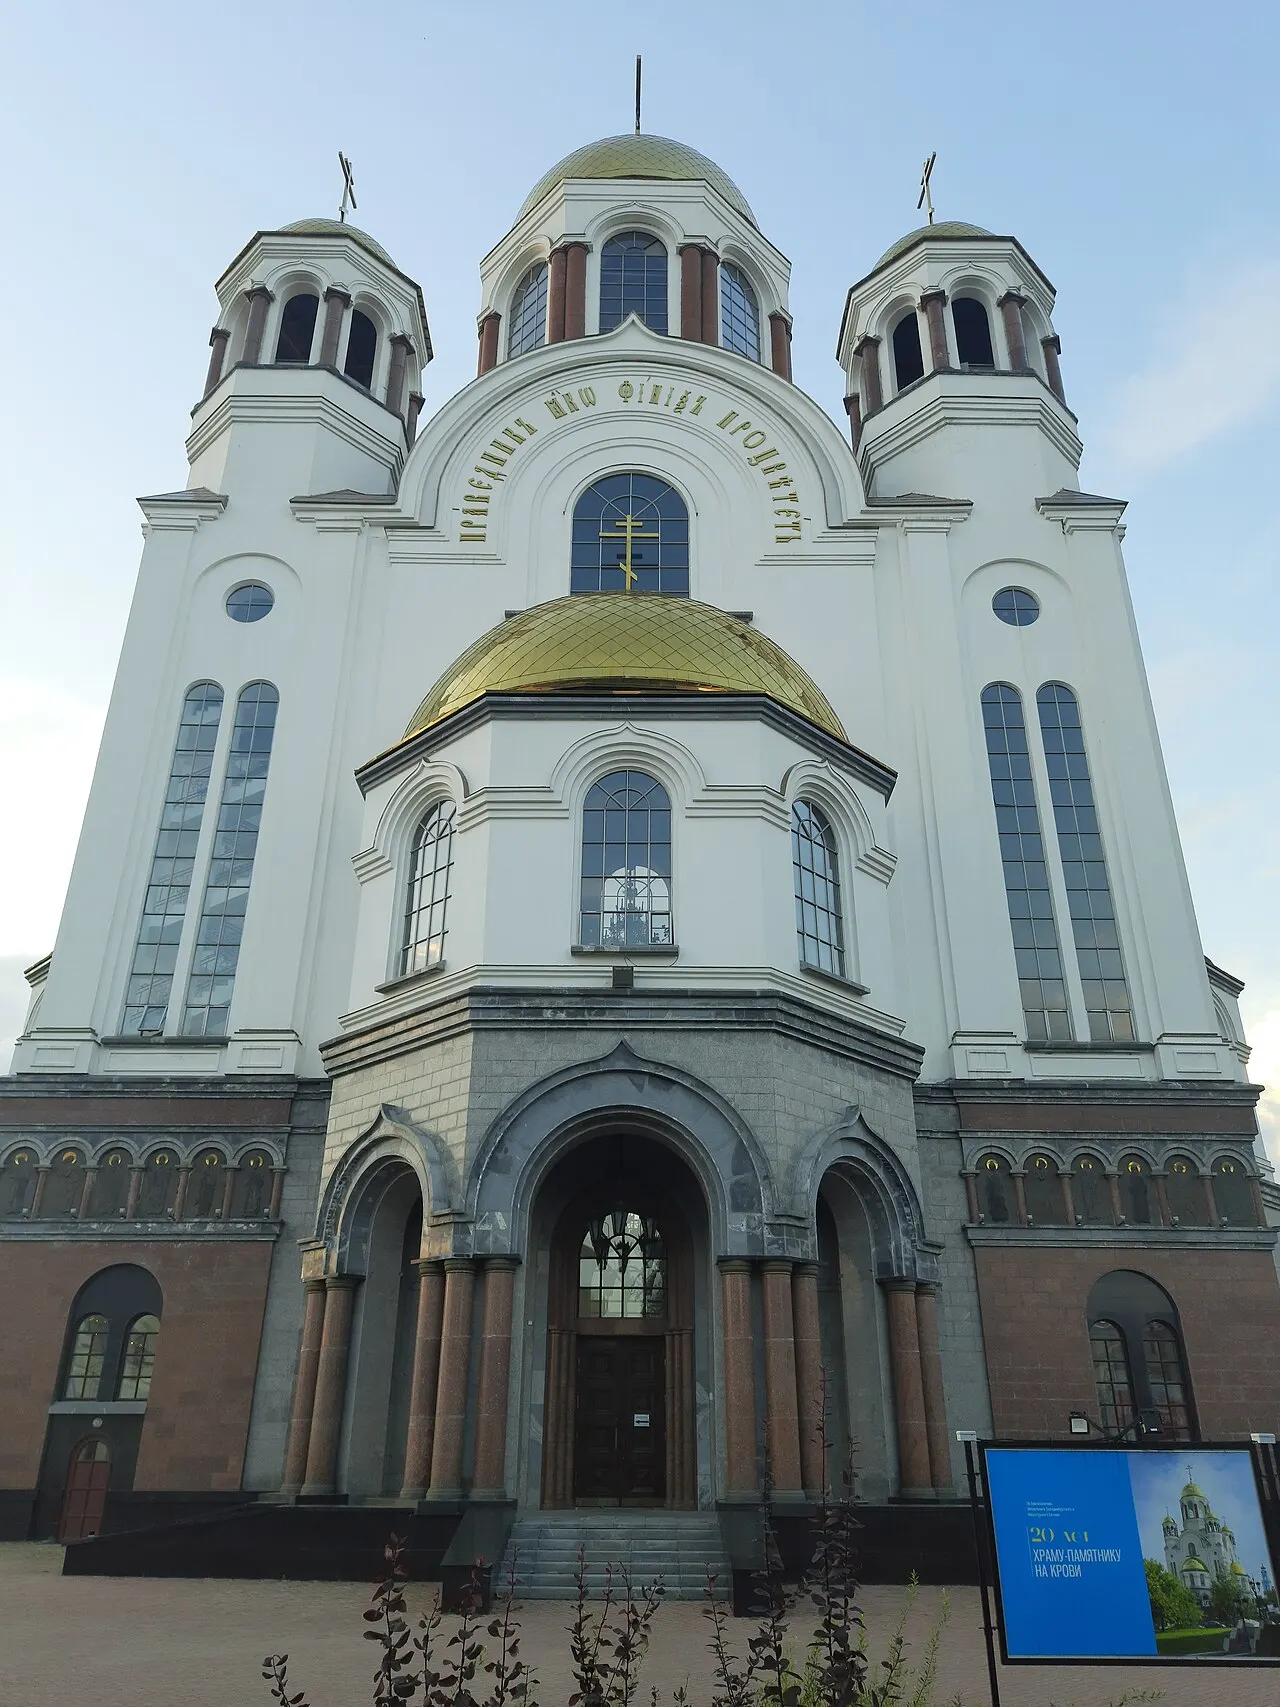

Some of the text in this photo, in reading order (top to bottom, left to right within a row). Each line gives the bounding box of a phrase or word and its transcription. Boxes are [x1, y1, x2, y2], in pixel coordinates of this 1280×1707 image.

[1030, 1527, 1055, 1542] 20
[1033, 1548, 1121, 1562] ХРАМУ-ПАМЯТНИКУ
[1035, 1564, 1082, 1578] НА КРОВИ
